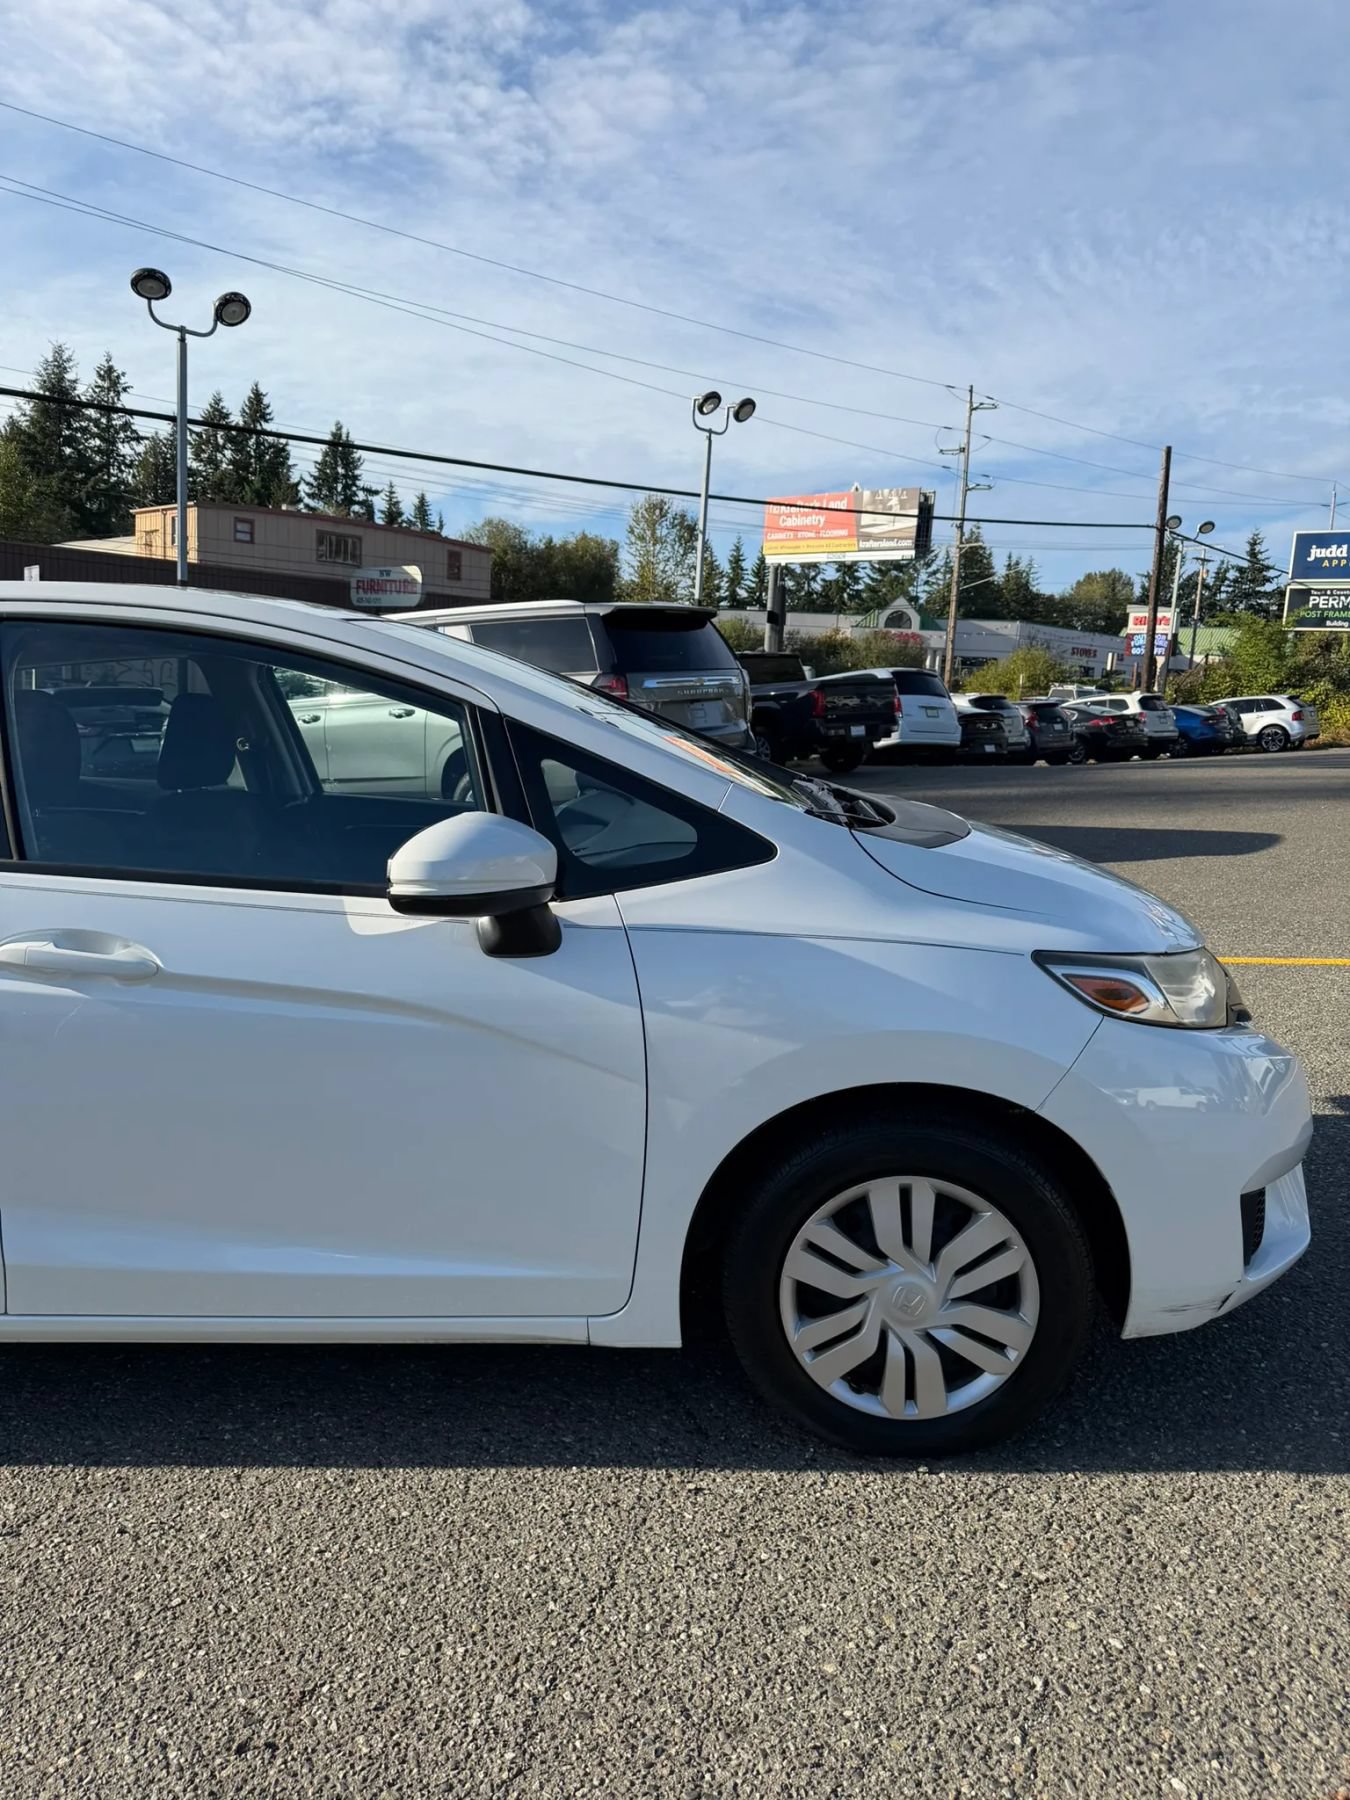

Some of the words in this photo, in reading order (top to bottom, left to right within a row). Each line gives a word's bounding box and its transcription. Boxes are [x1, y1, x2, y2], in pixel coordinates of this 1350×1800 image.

[823, 497, 848, 510] Land
[779, 514, 825, 527] Cabinetry
[1307, 545, 1348, 561] judd
[1322, 559, 1350, 567] APP
[356, 579, 417, 595] FURNITURE
[1309, 596, 1350, 608] PERM
